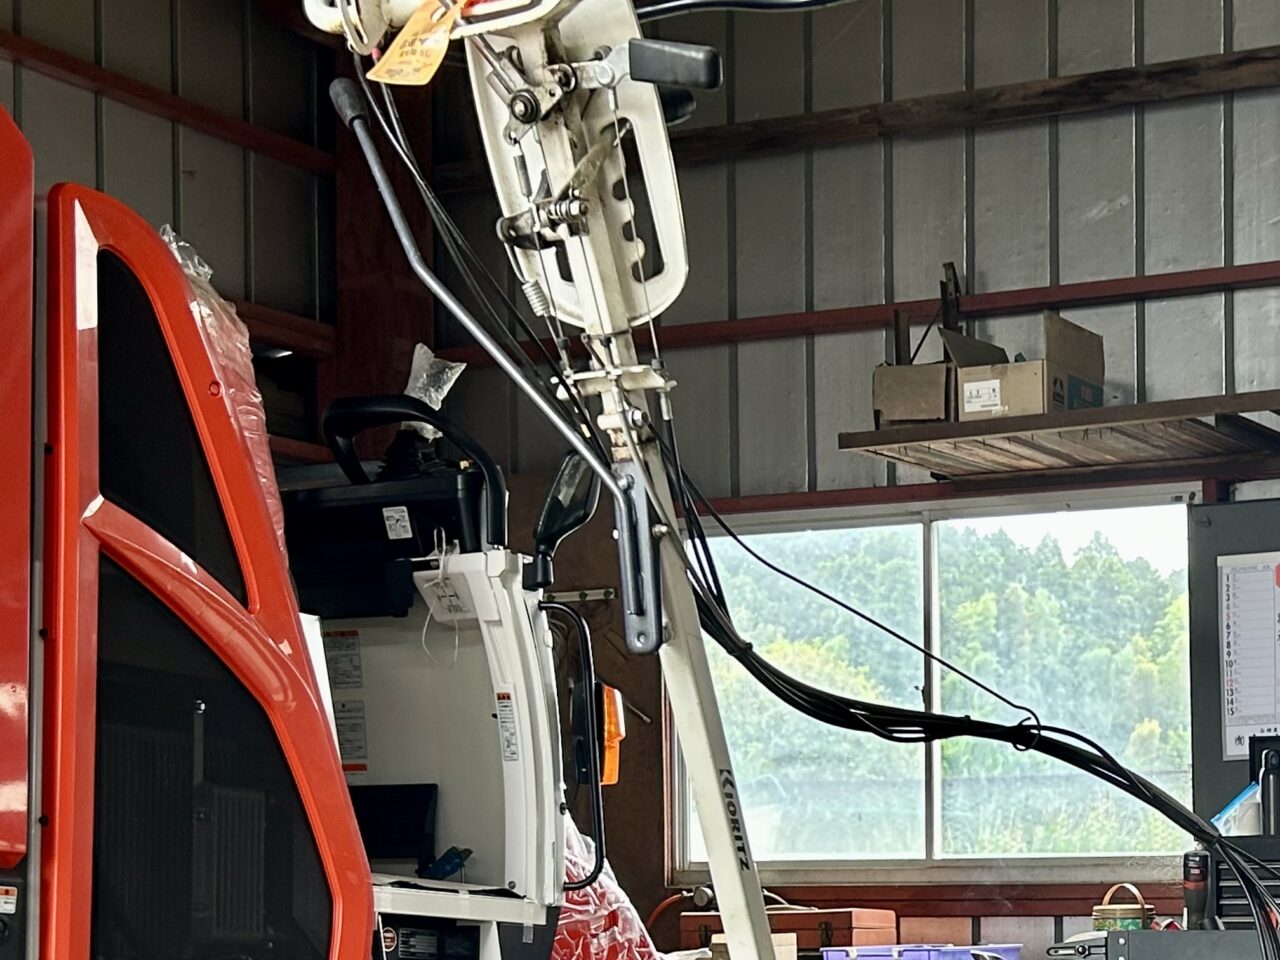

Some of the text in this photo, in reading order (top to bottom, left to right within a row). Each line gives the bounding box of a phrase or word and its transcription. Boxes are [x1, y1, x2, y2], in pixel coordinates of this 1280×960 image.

[1225, 660, 1233, 668] 10
[1226, 669, 1233, 677] 11
[1226, 679, 1233, 687] 12
[1226, 689, 1234, 697] 13
[1226, 698, 1234, 706] 14
[1227, 708, 1234, 716] 15
[719, 769, 750, 871] KIORITZ
